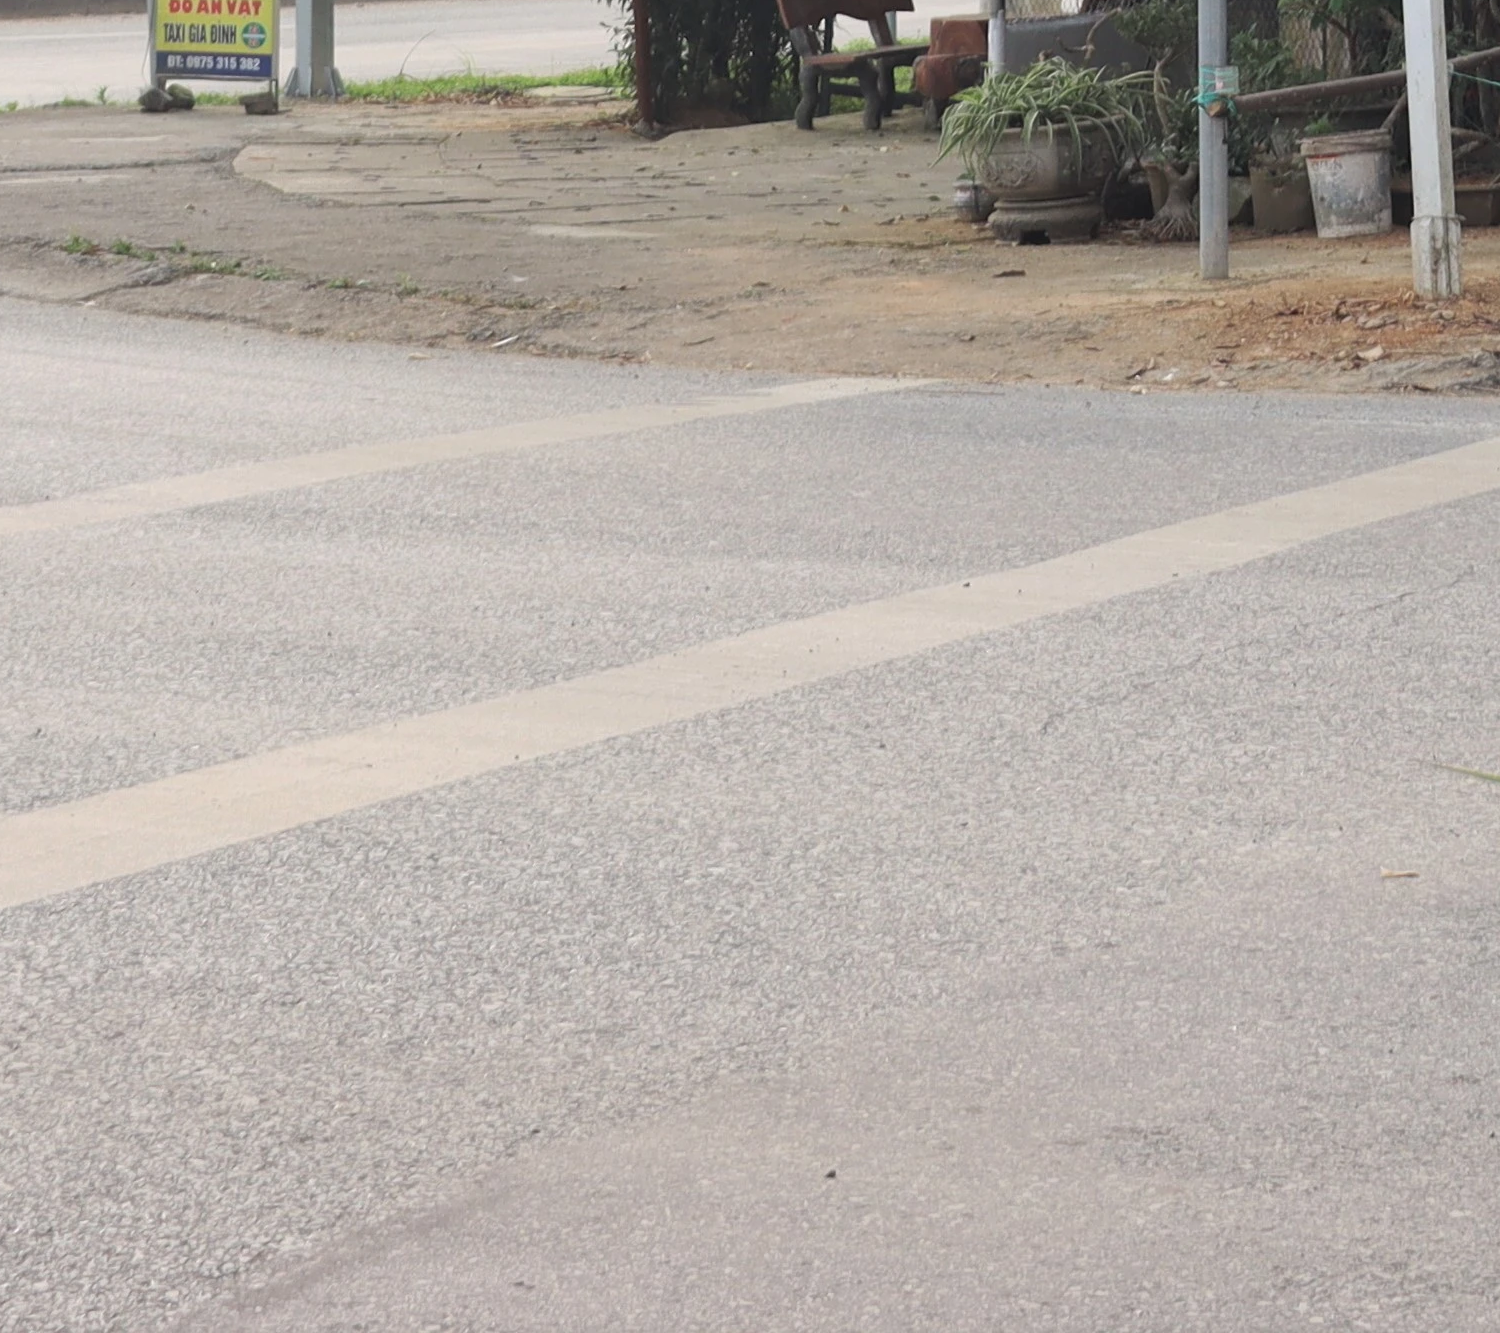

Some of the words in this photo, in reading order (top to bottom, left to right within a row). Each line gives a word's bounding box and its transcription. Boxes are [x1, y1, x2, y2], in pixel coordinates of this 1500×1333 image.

[163, 23, 186, 43] TAXI
[189, 24, 207, 43] GIA
[186, 55, 214, 70] 0975
[216, 56, 237, 70] 315
